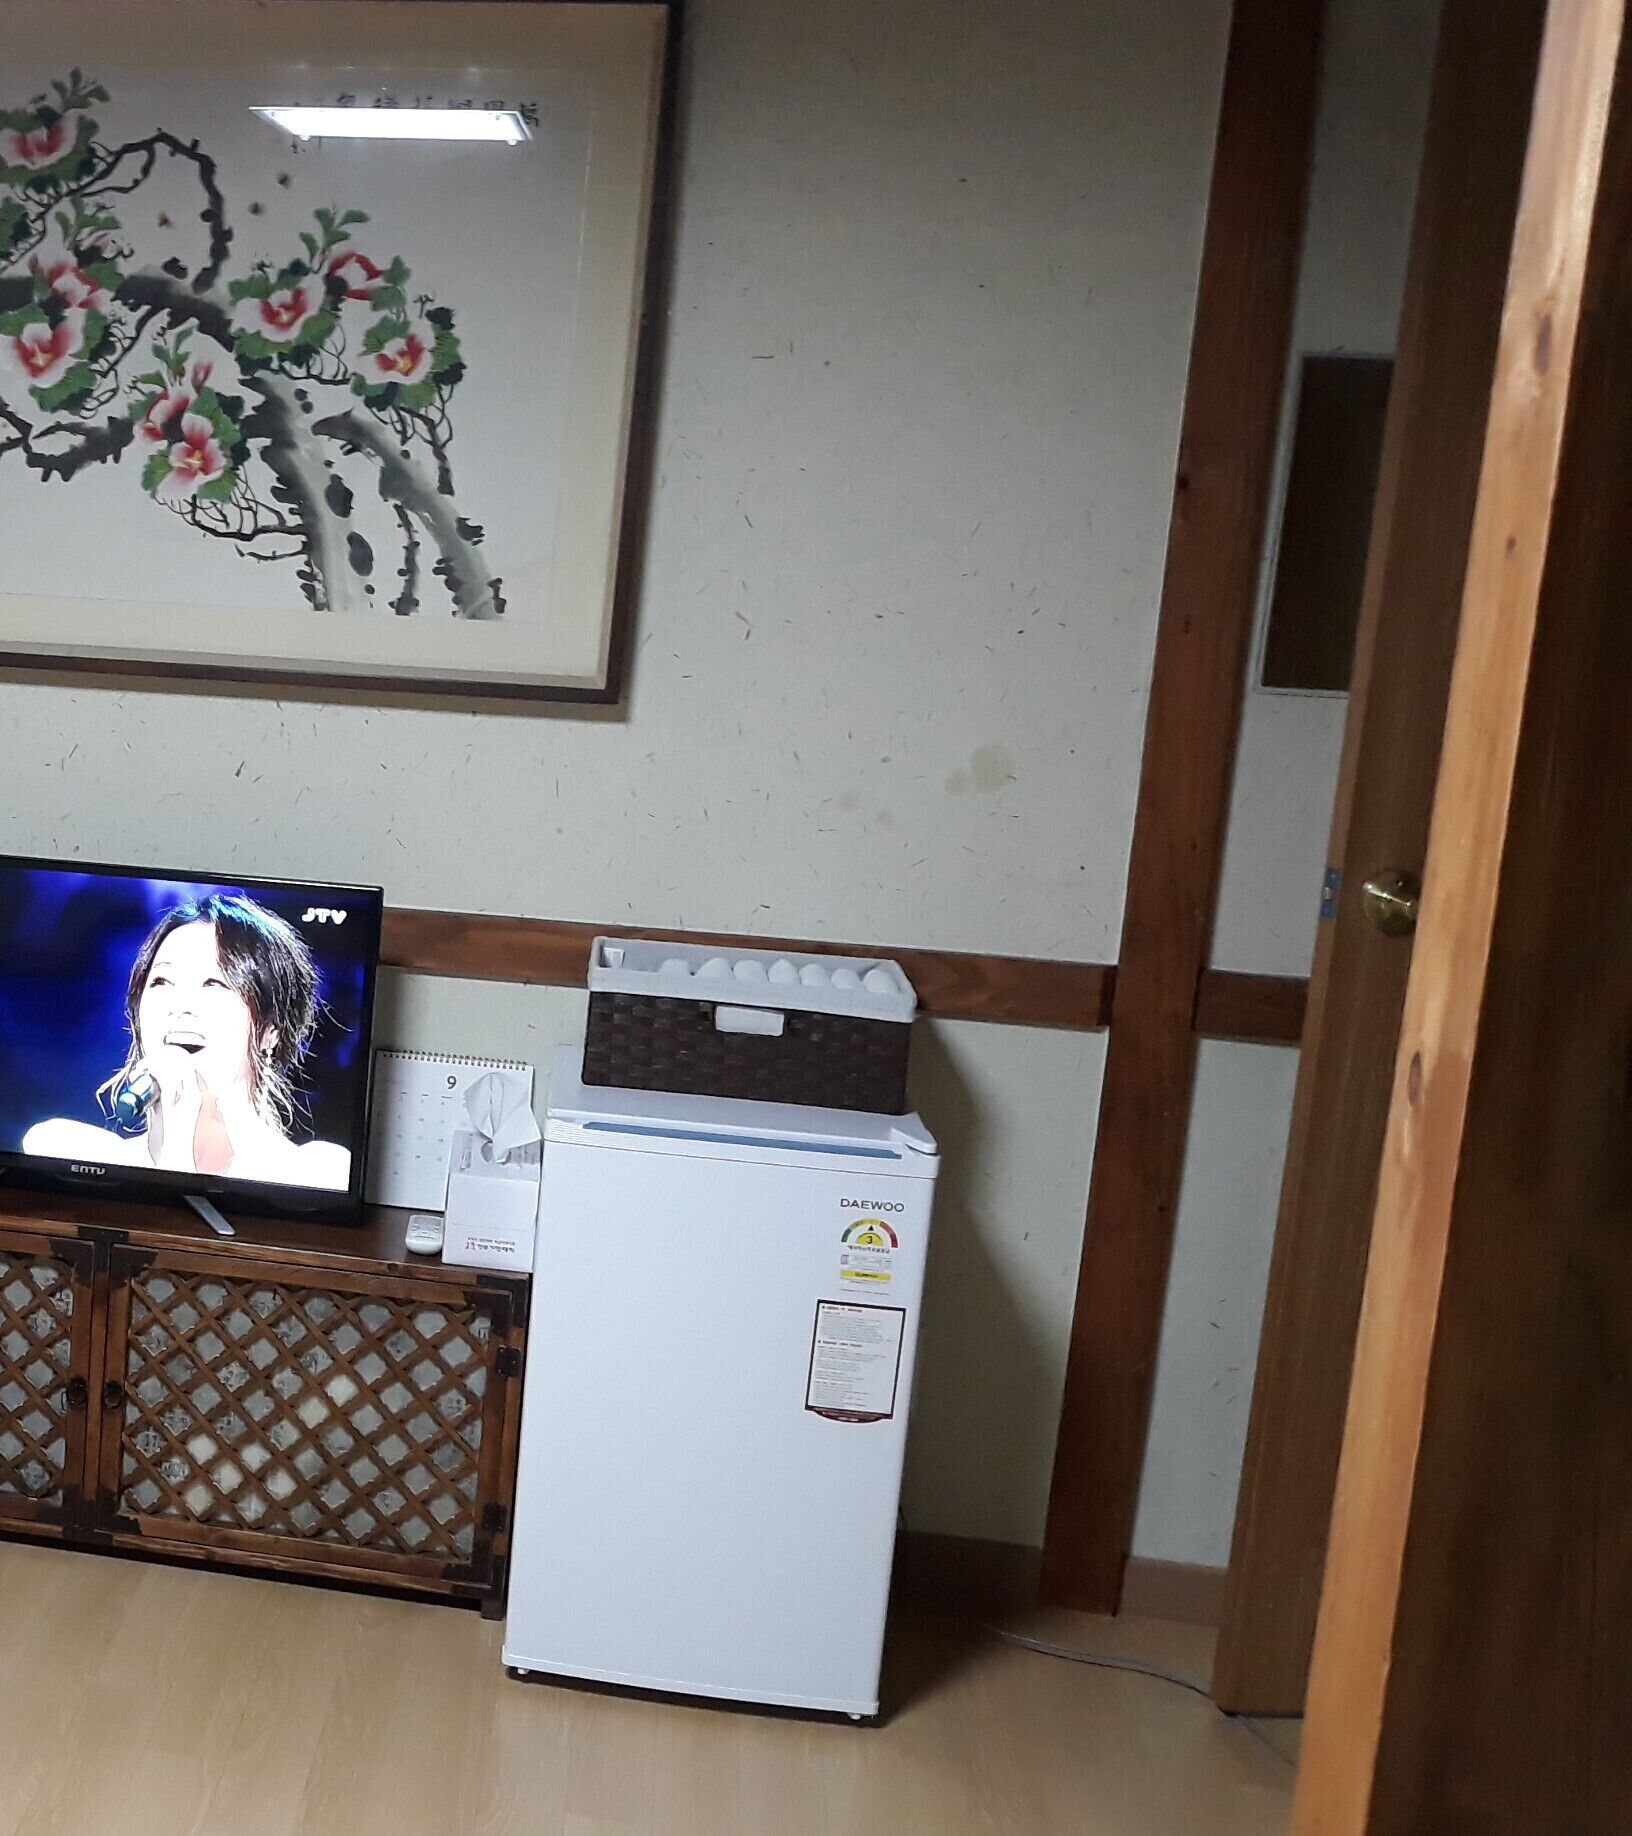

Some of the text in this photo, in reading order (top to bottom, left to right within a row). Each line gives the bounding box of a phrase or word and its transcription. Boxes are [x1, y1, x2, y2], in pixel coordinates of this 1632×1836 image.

[301, 907, 347, 925] JTV
[446, 1075, 458, 1090] 9
[840, 1198, 905, 1212] DAEWOO
[866, 1235, 874, 1244] 3
